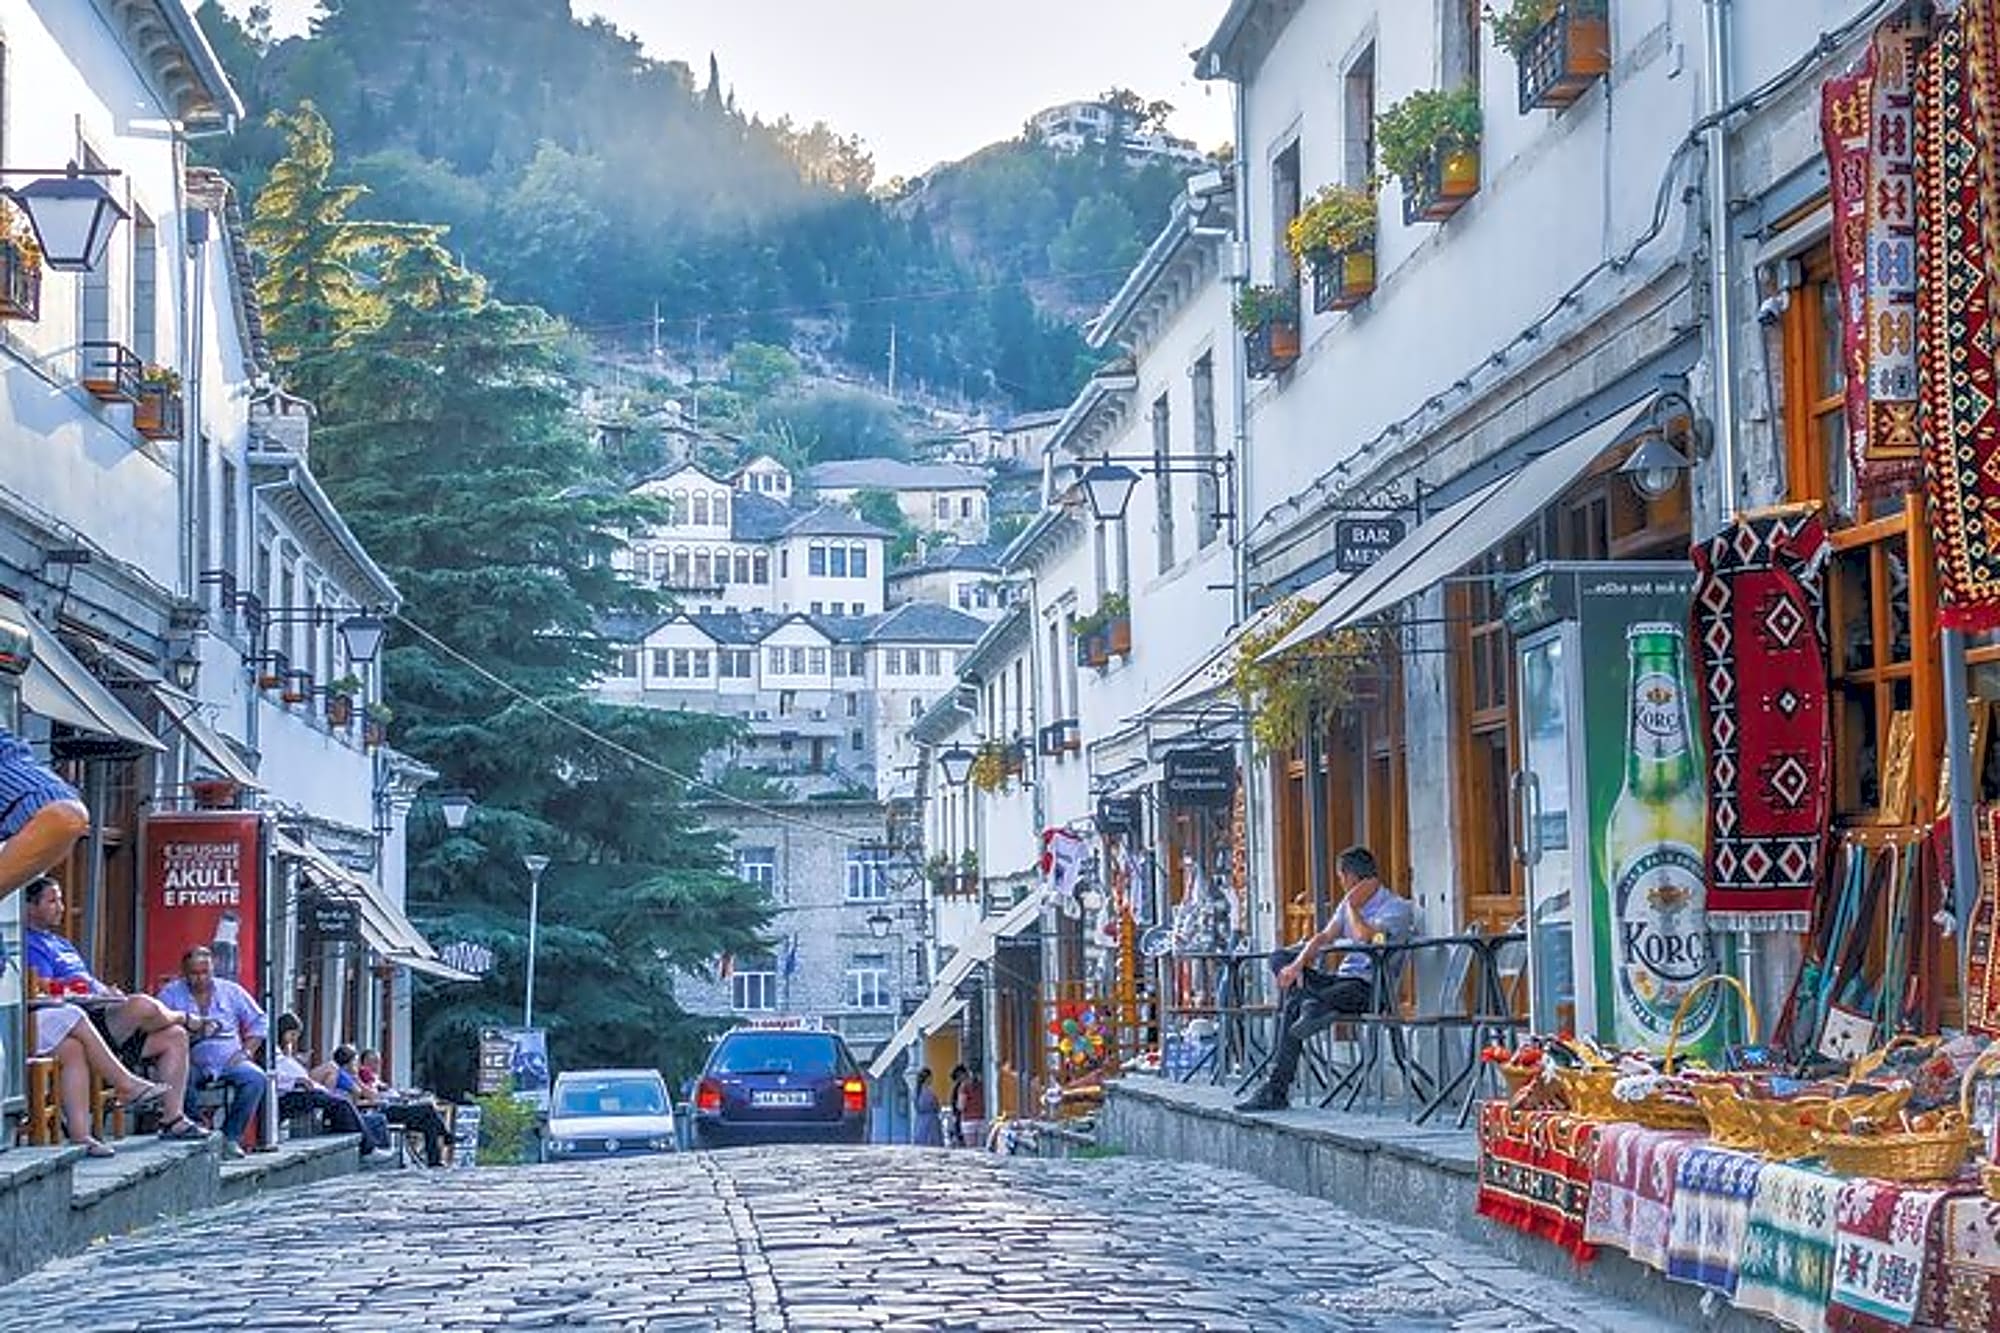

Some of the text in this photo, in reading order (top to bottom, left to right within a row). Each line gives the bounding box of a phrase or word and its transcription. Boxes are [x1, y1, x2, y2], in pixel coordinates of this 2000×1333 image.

[1352, 527, 1390, 543] BAR
[164, 868, 240, 889] AKULL
[164, 890, 177, 907] E
